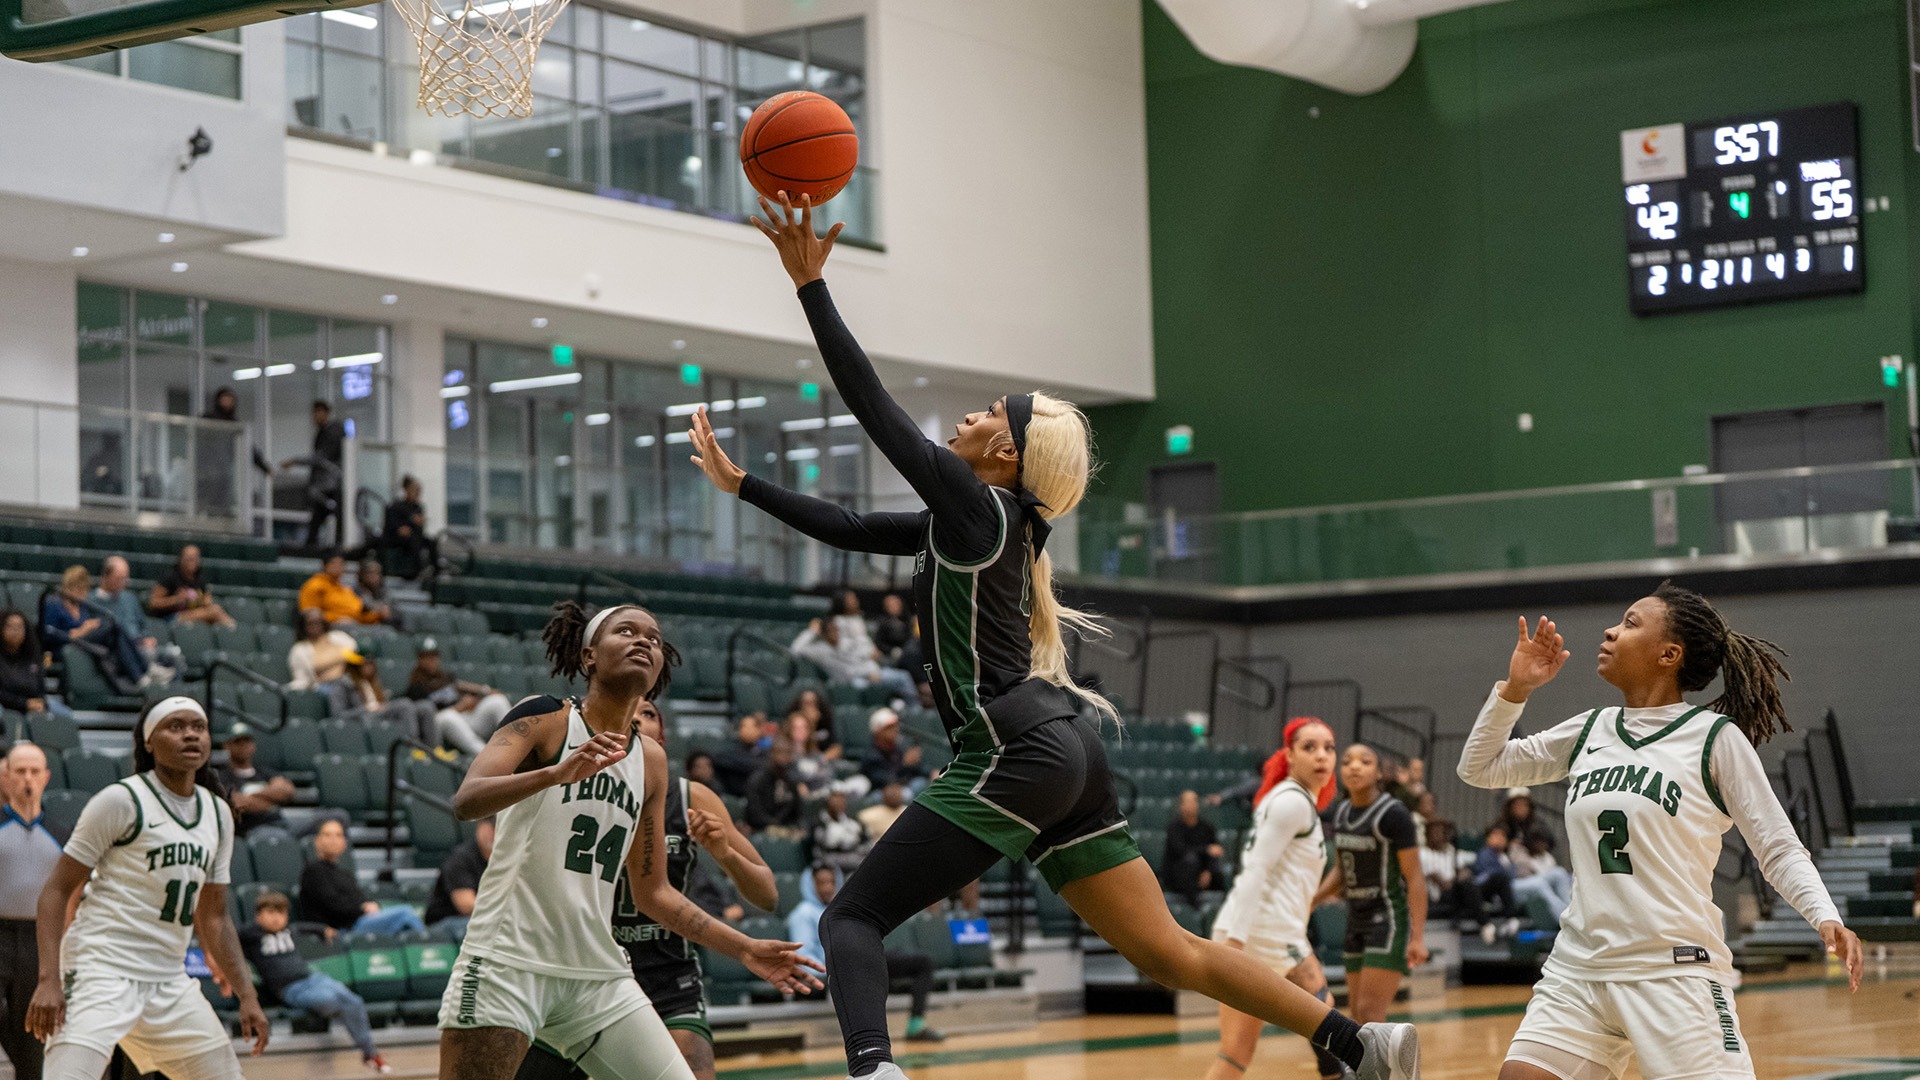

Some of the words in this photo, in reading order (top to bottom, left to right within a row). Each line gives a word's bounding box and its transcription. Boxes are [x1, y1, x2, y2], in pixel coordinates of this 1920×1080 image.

[1637, 201, 1678, 240] 42
[1730, 193, 1749, 218] 4
[1811, 179, 1853, 220] 55
[1570, 765, 1683, 817] THOMAS
[564, 813, 628, 884] 24
[1597, 809, 1633, 875] 2
